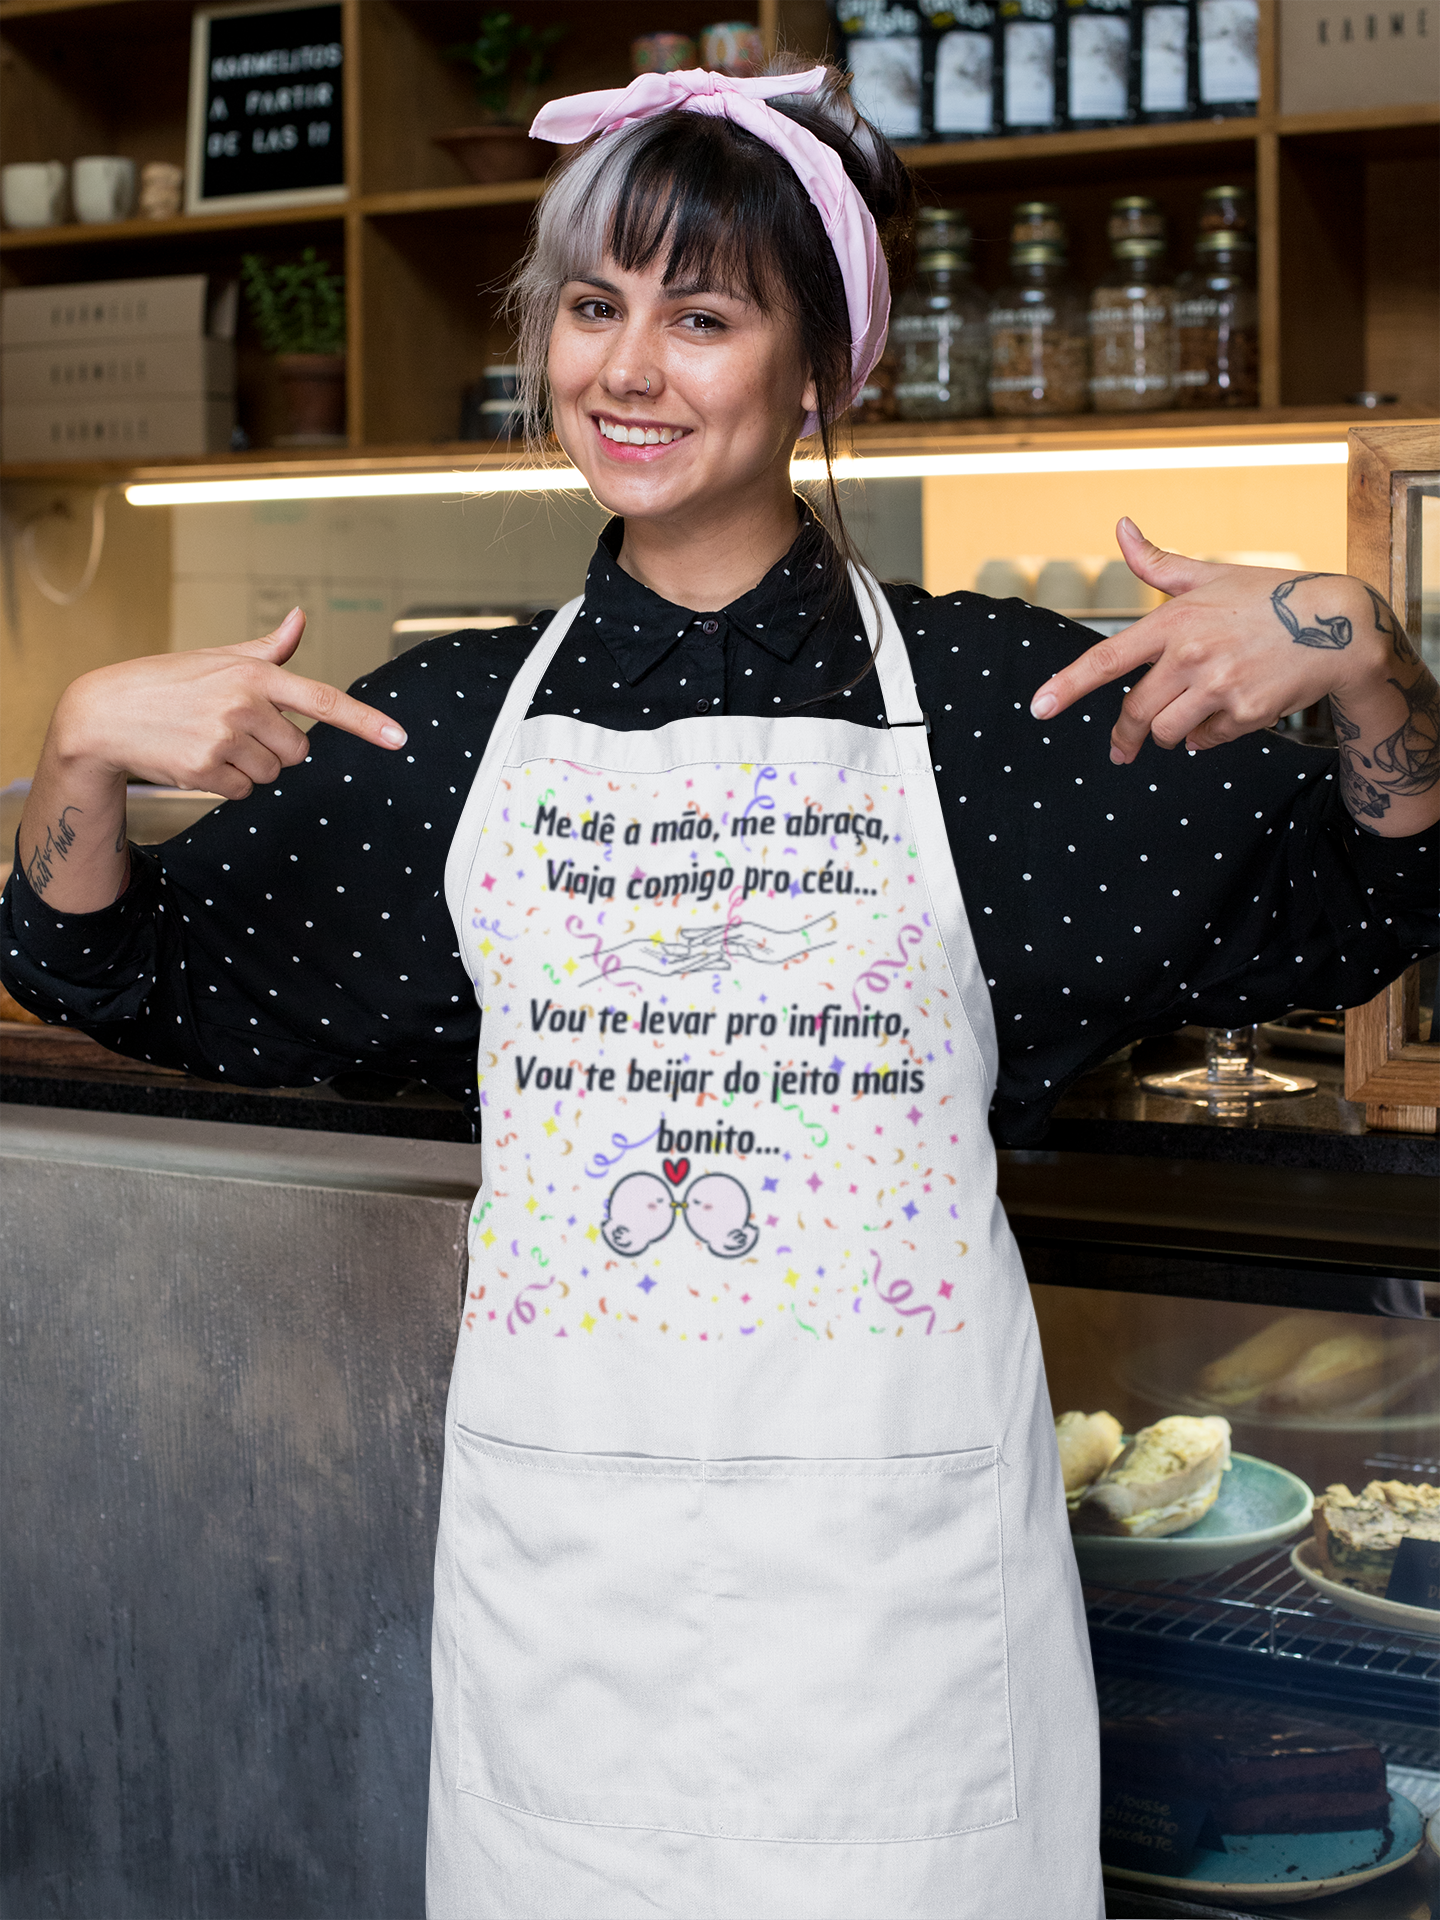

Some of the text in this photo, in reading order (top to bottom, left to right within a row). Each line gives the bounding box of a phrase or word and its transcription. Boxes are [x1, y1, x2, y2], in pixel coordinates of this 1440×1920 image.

[209, 82, 333, 122] A PARTIR
[207, 130, 240, 158] DE
[252, 124, 298, 154] LAS
[534, 804, 889, 846] Me dê a mão, me abraça,
[547, 859, 878, 905] Viaja comigo pro céu...
[530, 998, 910, 1047] Vou te levar pro infinito,
[515, 1055, 925, 1104] Vou te beijar do jeito mais
[656, 1118, 780, 1155] bonito...
